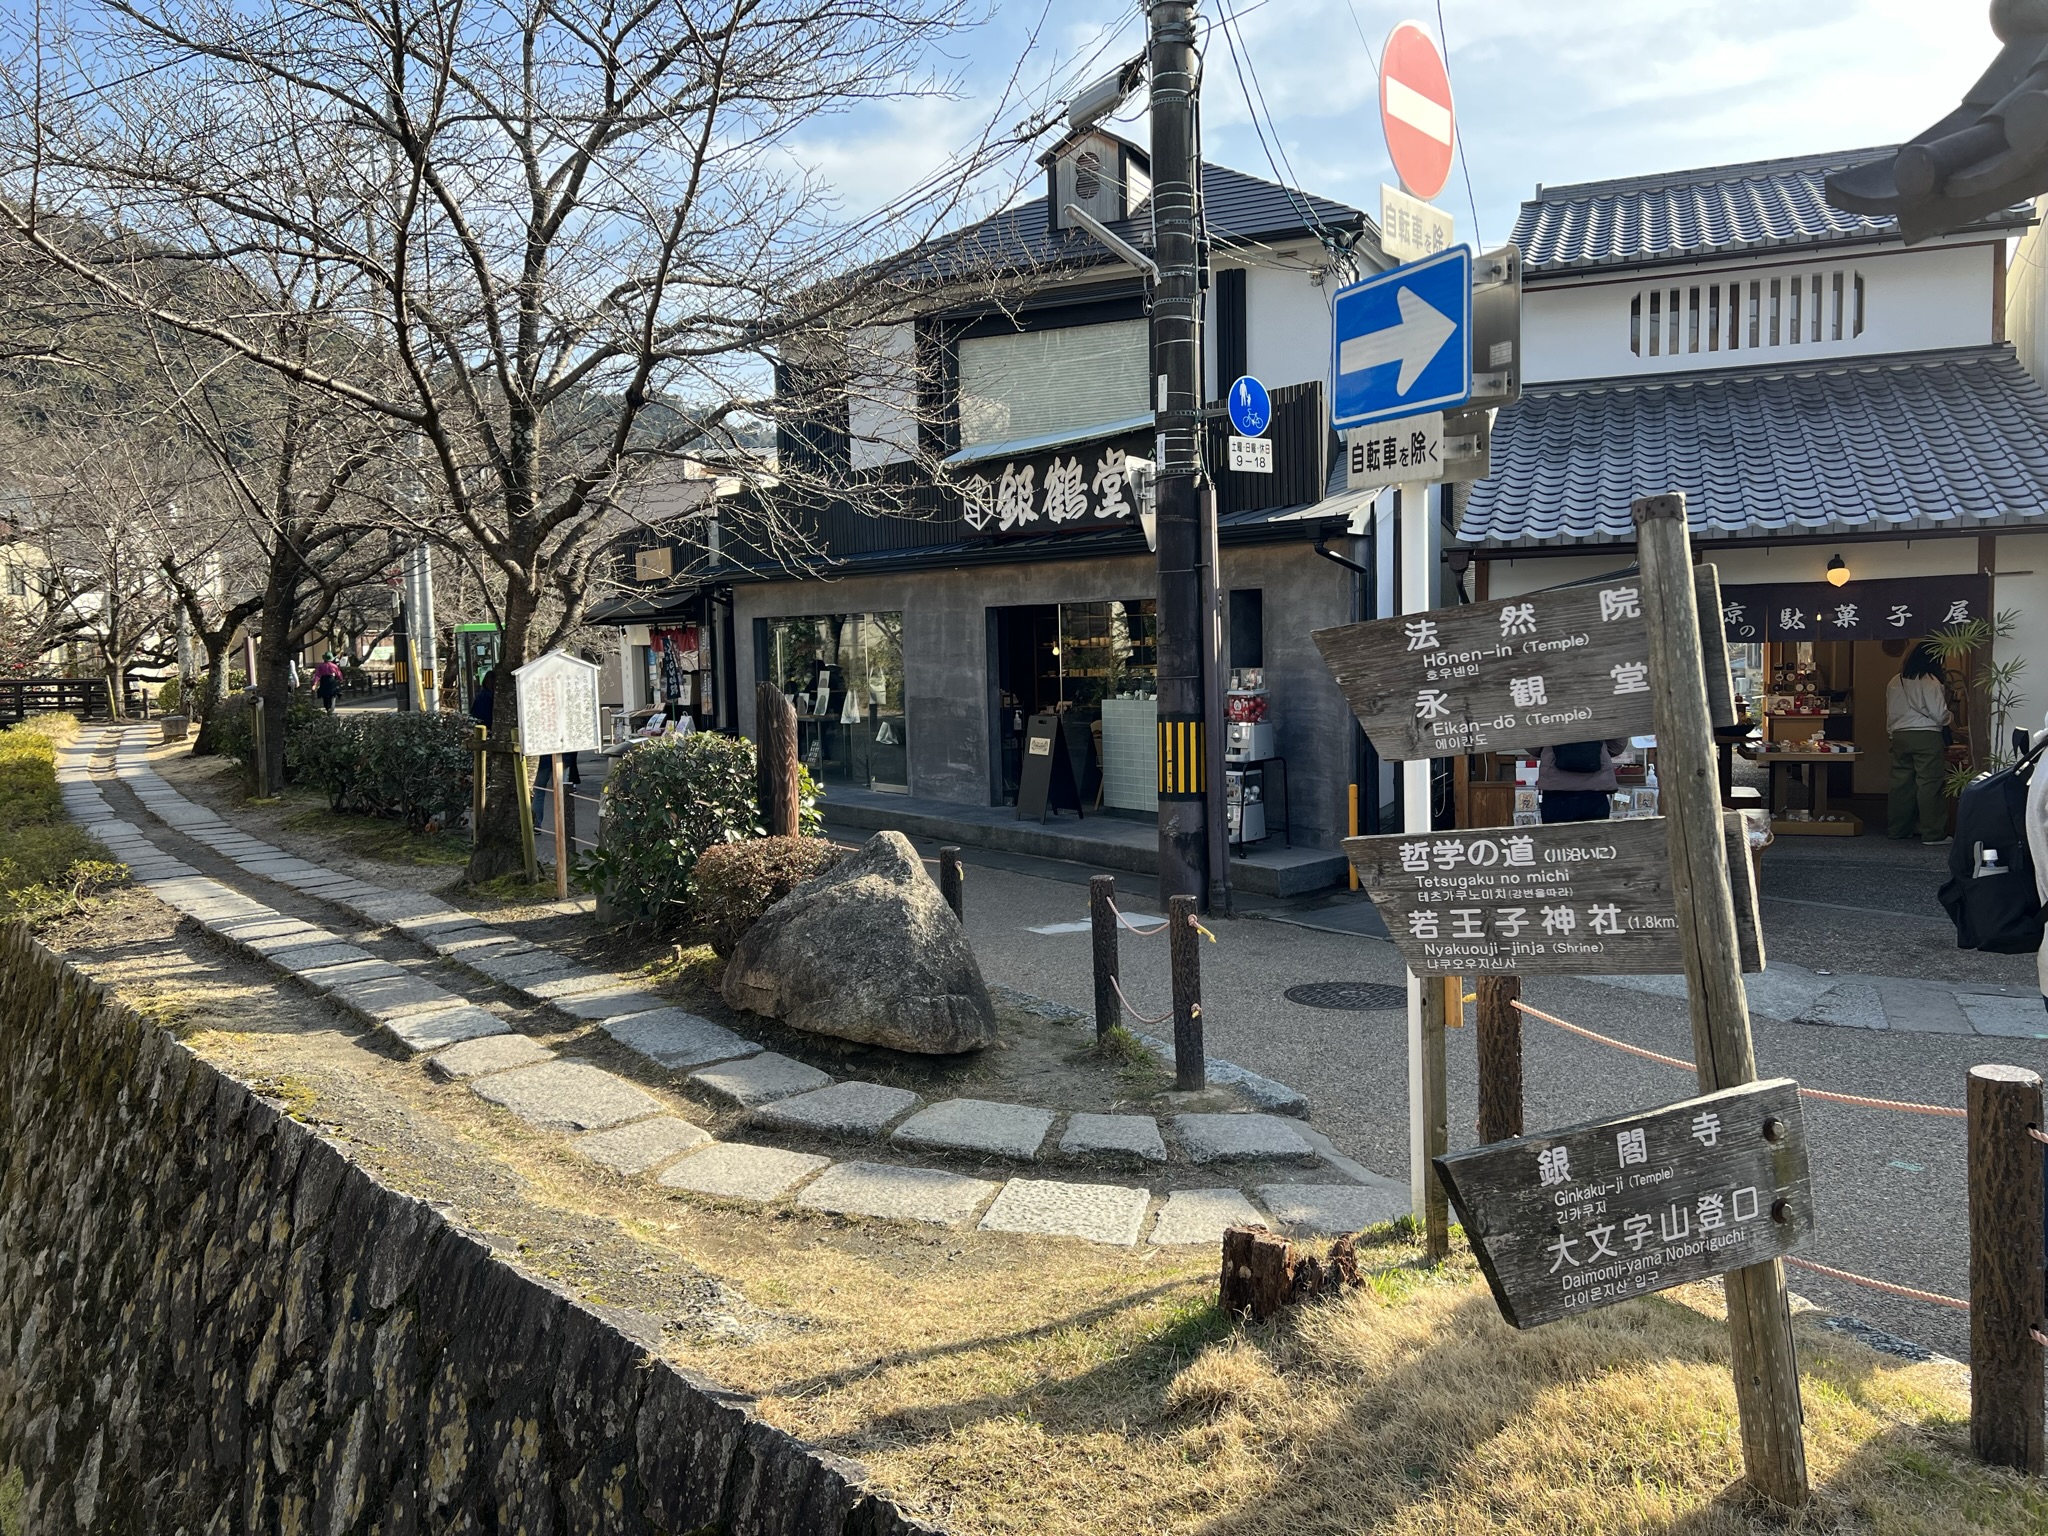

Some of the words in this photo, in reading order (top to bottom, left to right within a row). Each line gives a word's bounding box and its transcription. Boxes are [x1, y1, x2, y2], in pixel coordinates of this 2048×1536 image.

[1385, 202, 1451, 254] 自転車を除
[1351, 431, 1438, 474] 自転車を除く
[997, 447, 1131, 531] 銀鶴堂
[1404, 586, 1641, 651] 法然院
[1722, 600, 1972, 637] 京の駄菓子屋
[1423, 644, 1513, 667] Hōnen-in
[1523, 633, 1590, 654] (Temple)
[1415, 661, 1650, 719] 永観堂
[1426, 664, 1479, 681] 호우넨인
[1433, 714, 1516, 737] Eikan-dō
[1526, 707, 1592, 726] (Temple)
[1435, 734, 1488, 749] 에이칸도
[1399, 835, 1537, 871] 哲学の道
[1544, 846, 1617, 863] (川沿いに)
[1414, 873, 1494, 889] Tetsugaku
[1500, 874, 1520, 885] no
[1527, 869, 1570, 882] michi
[1408, 903, 1627, 940] 若王子神社
[1424, 941, 1545, 957] Nyakuouji-jinja
[1552, 942, 1604, 954] (Shrine)
[1427, 957, 1517, 970] 냐쿠오우지신사
[1537, 1111, 1722, 1188] 銀閣寺
[1554, 1176, 1624, 1206] Ginkaku-ji
[1629, 1166, 1674, 1188] (Temple)
[1548, 1186, 1759, 1273] 大文字山登口
[1556, 1200, 1607, 1225] 긴카쿠지
[1562, 1253, 1662, 1290] Daimonji-yama
[1666, 1227, 1745, 1262] Noboriguchi
[1564, 1280, 1628, 1309] 다이몬지산
[1635, 1270, 1660, 1289] 입구
